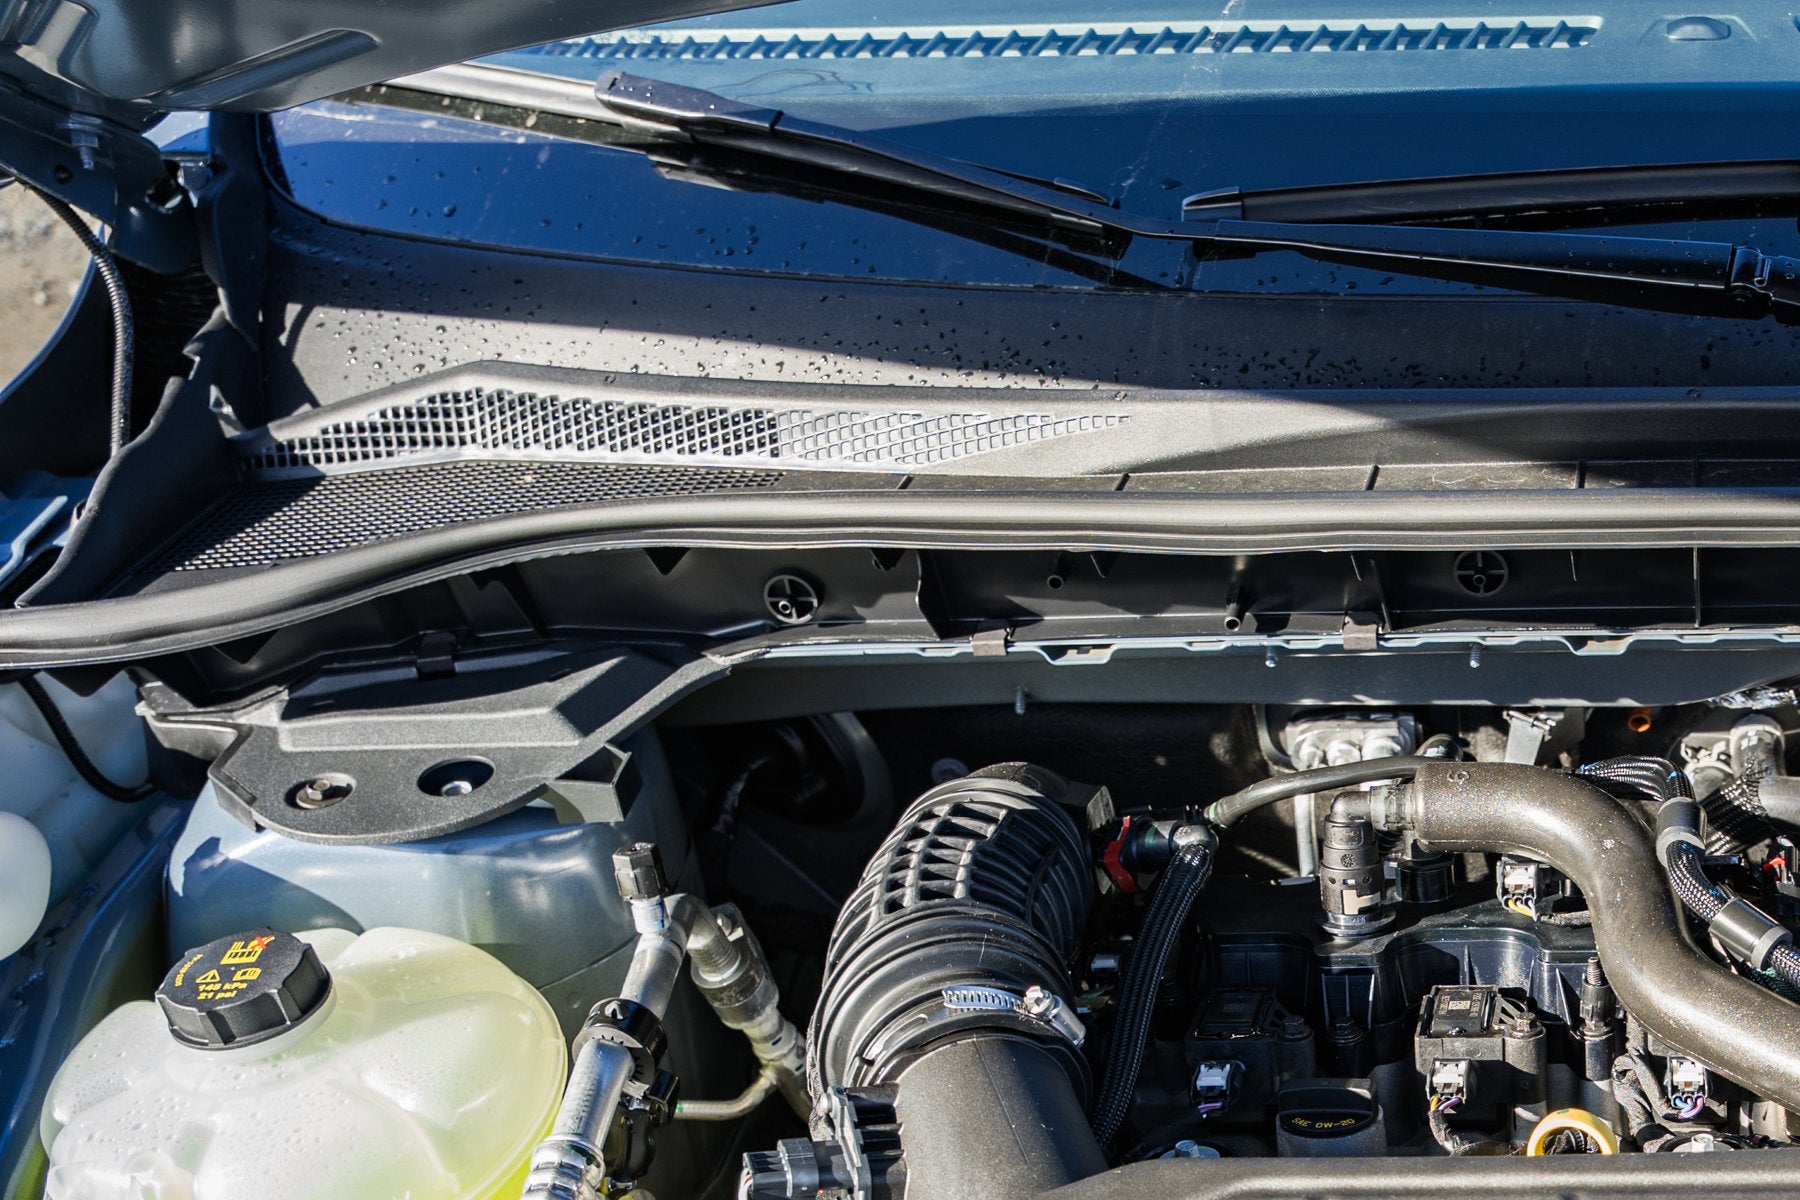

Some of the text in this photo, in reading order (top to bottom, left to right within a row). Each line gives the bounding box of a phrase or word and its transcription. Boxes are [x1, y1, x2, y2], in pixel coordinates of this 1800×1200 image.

[198, 982, 247, 991] 145 kPa
[197, 990, 236, 1000] 21 psi
[1292, 1117, 1355, 1129] SAE 0W-20
